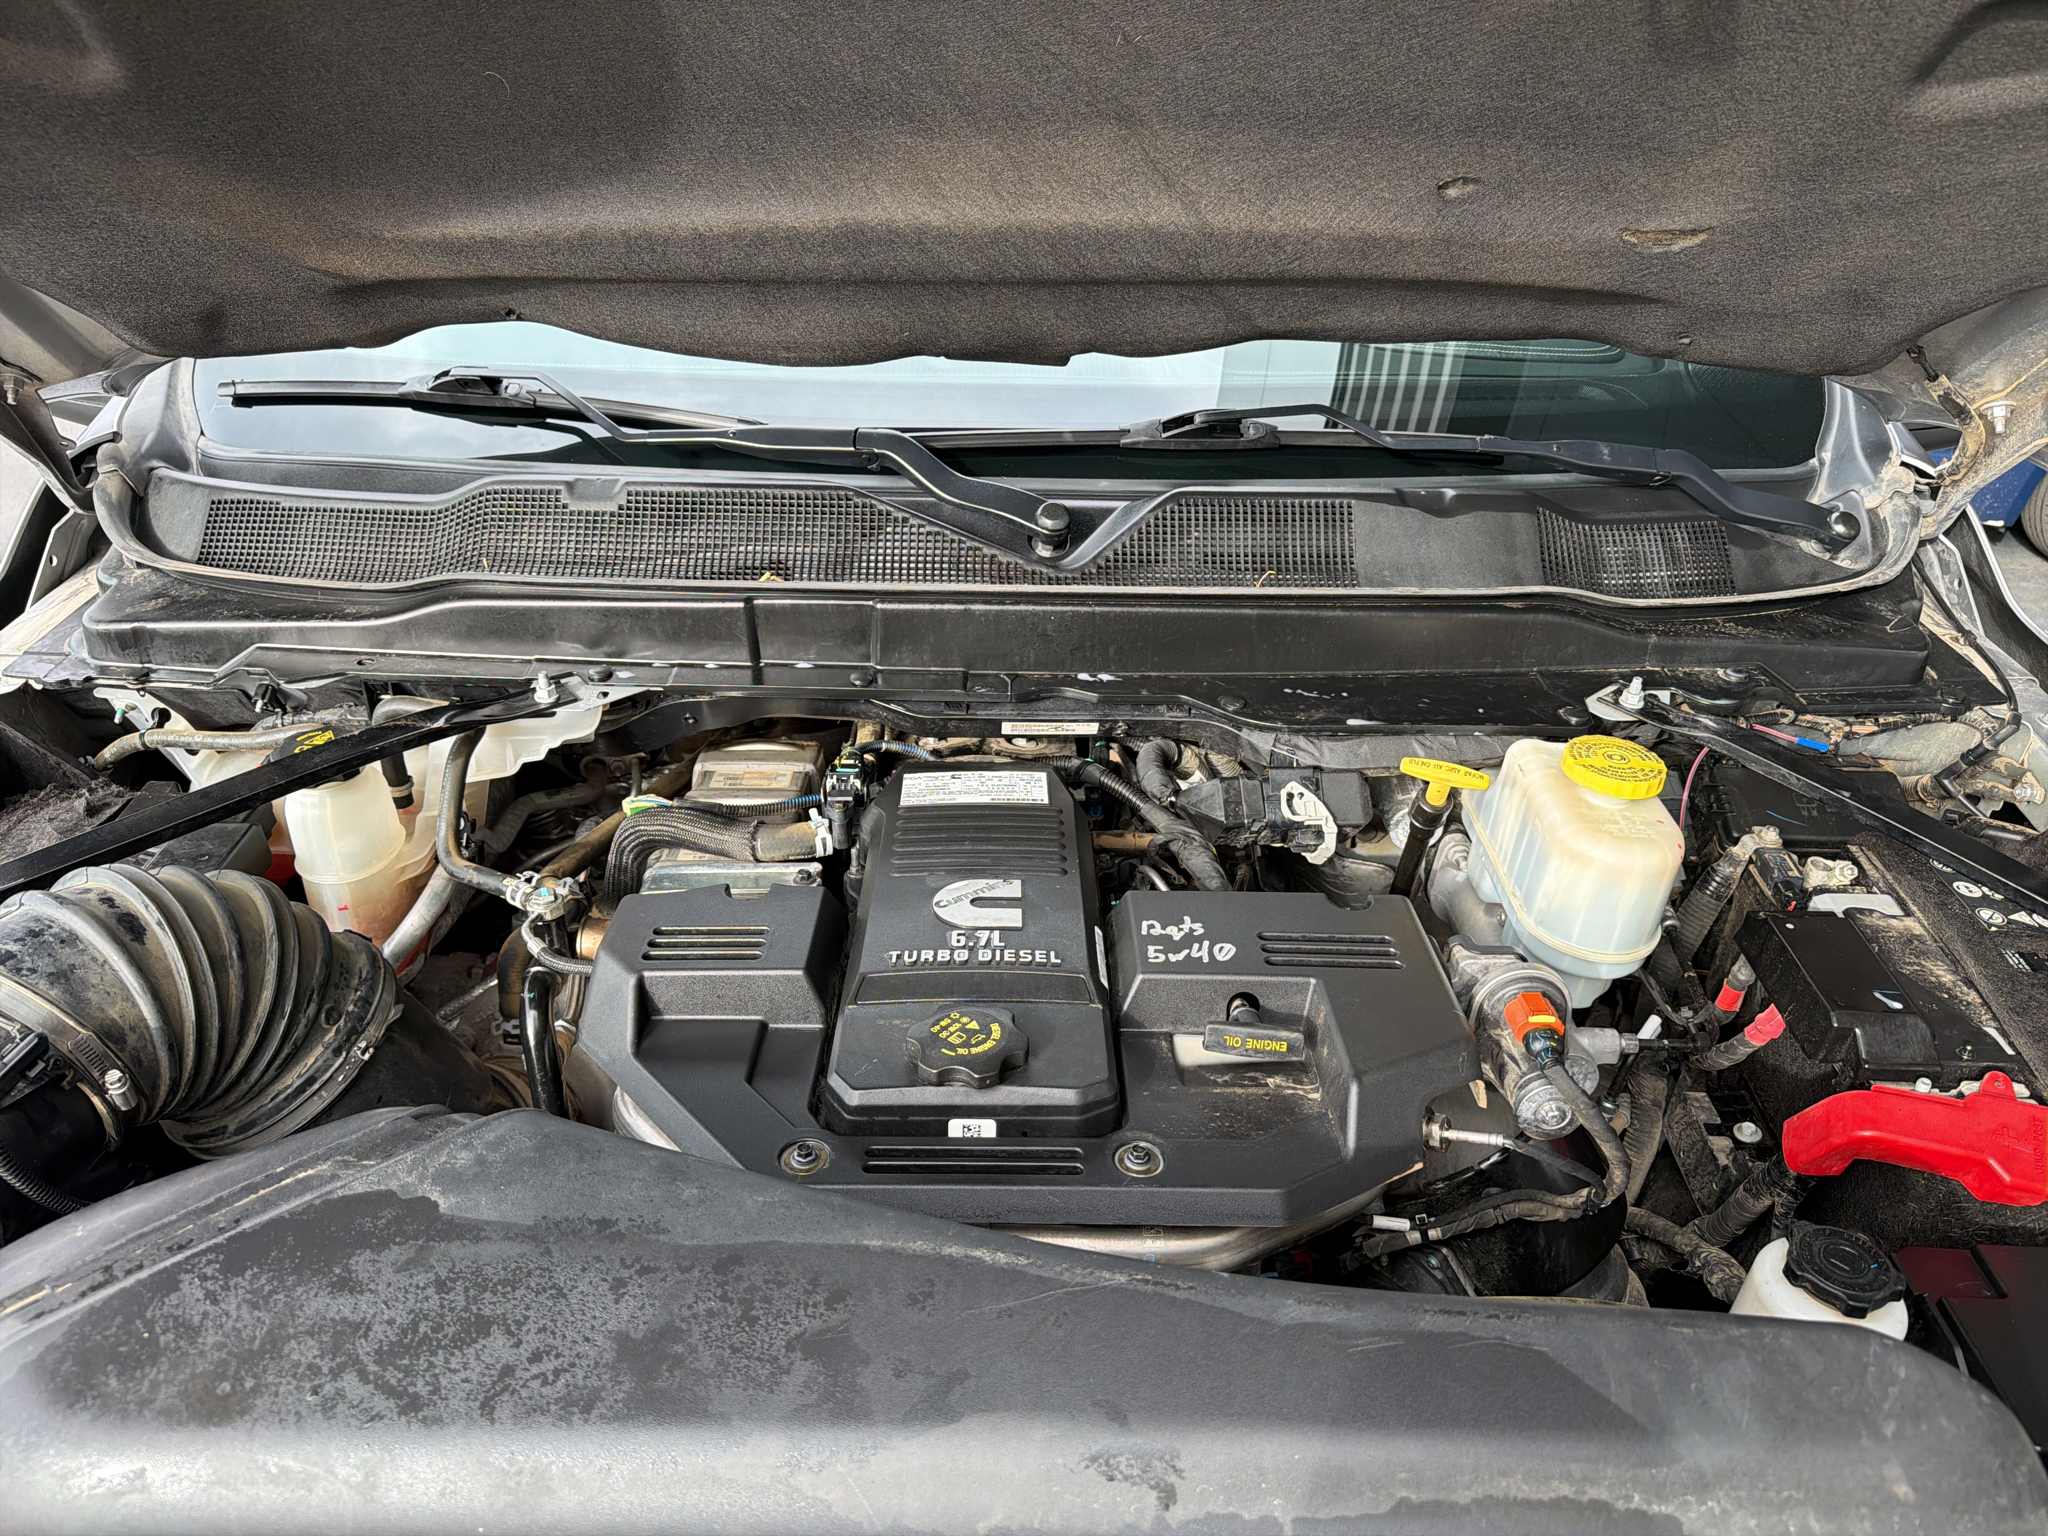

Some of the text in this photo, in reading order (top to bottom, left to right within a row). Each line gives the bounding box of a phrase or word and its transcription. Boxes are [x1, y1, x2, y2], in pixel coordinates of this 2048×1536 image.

[949, 930, 1007, 949] 6.7L
[888, 949, 1063, 966] TURBO DIESEL
[1223, 1035, 1288, 1053] ENGINE OIL
